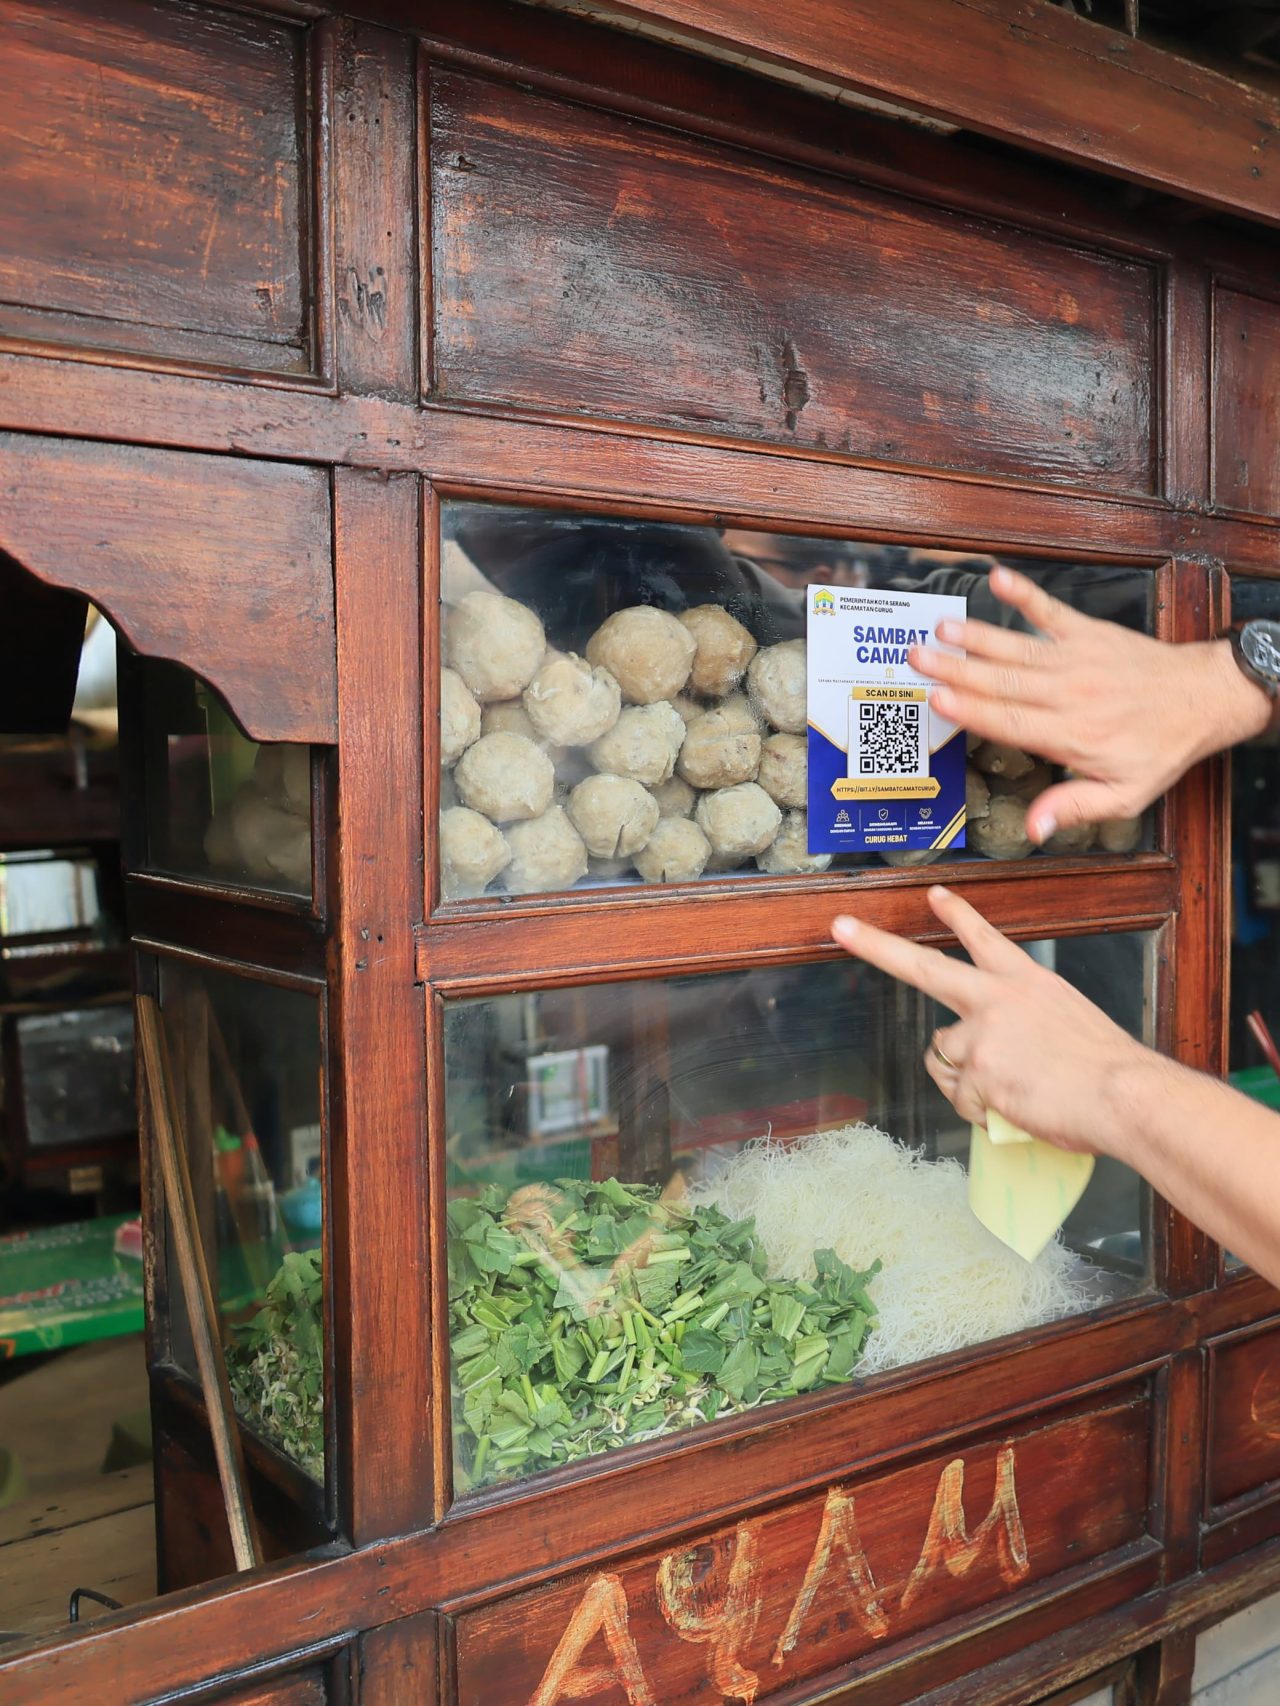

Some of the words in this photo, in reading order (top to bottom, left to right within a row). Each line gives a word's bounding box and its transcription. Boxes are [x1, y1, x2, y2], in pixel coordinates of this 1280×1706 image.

[840, 597, 874, 605] PEMERINTAH
[889, 600, 911, 608] SERANG
[853, 625, 929, 646] SAMBAT
[856, 645, 910, 665] CAMA
[865, 689, 887, 698] SCAN
[889, 689, 897, 698] DI
[898, 690, 914, 698] SINI
[864, 835, 886, 844] CURUG
[887, 834, 908, 843] HEBAT
